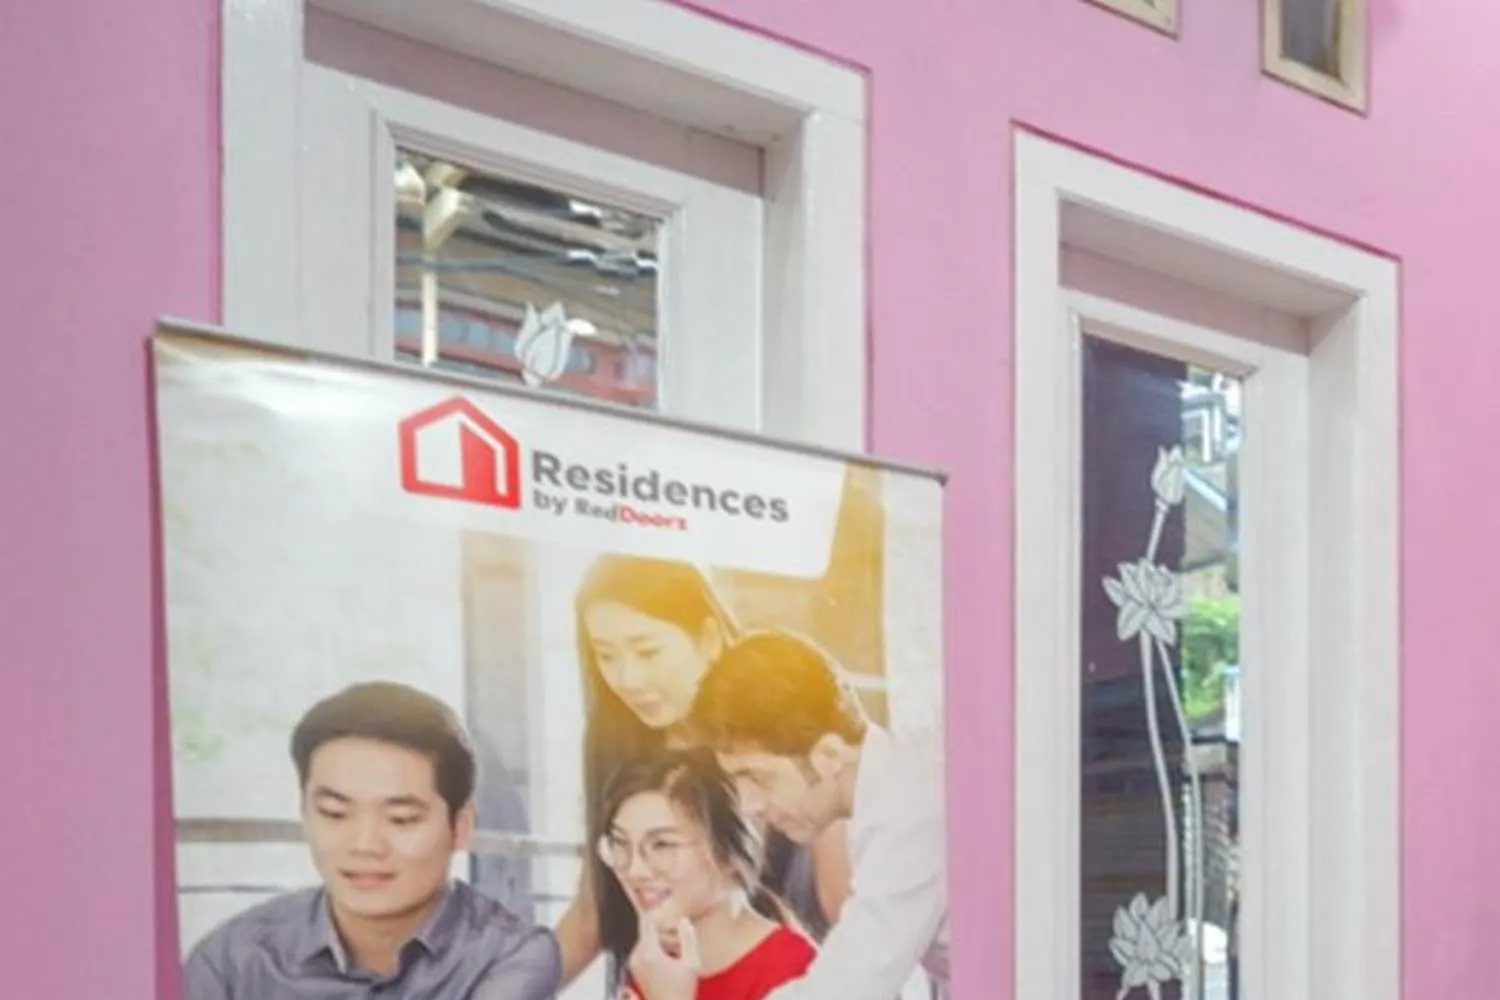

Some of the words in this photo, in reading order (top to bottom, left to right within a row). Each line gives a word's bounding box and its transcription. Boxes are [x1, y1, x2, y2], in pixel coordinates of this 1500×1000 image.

[532, 449, 789, 522] Residences
[534, 489, 567, 515] by
[575, 497, 687, 531] RedDoorz
